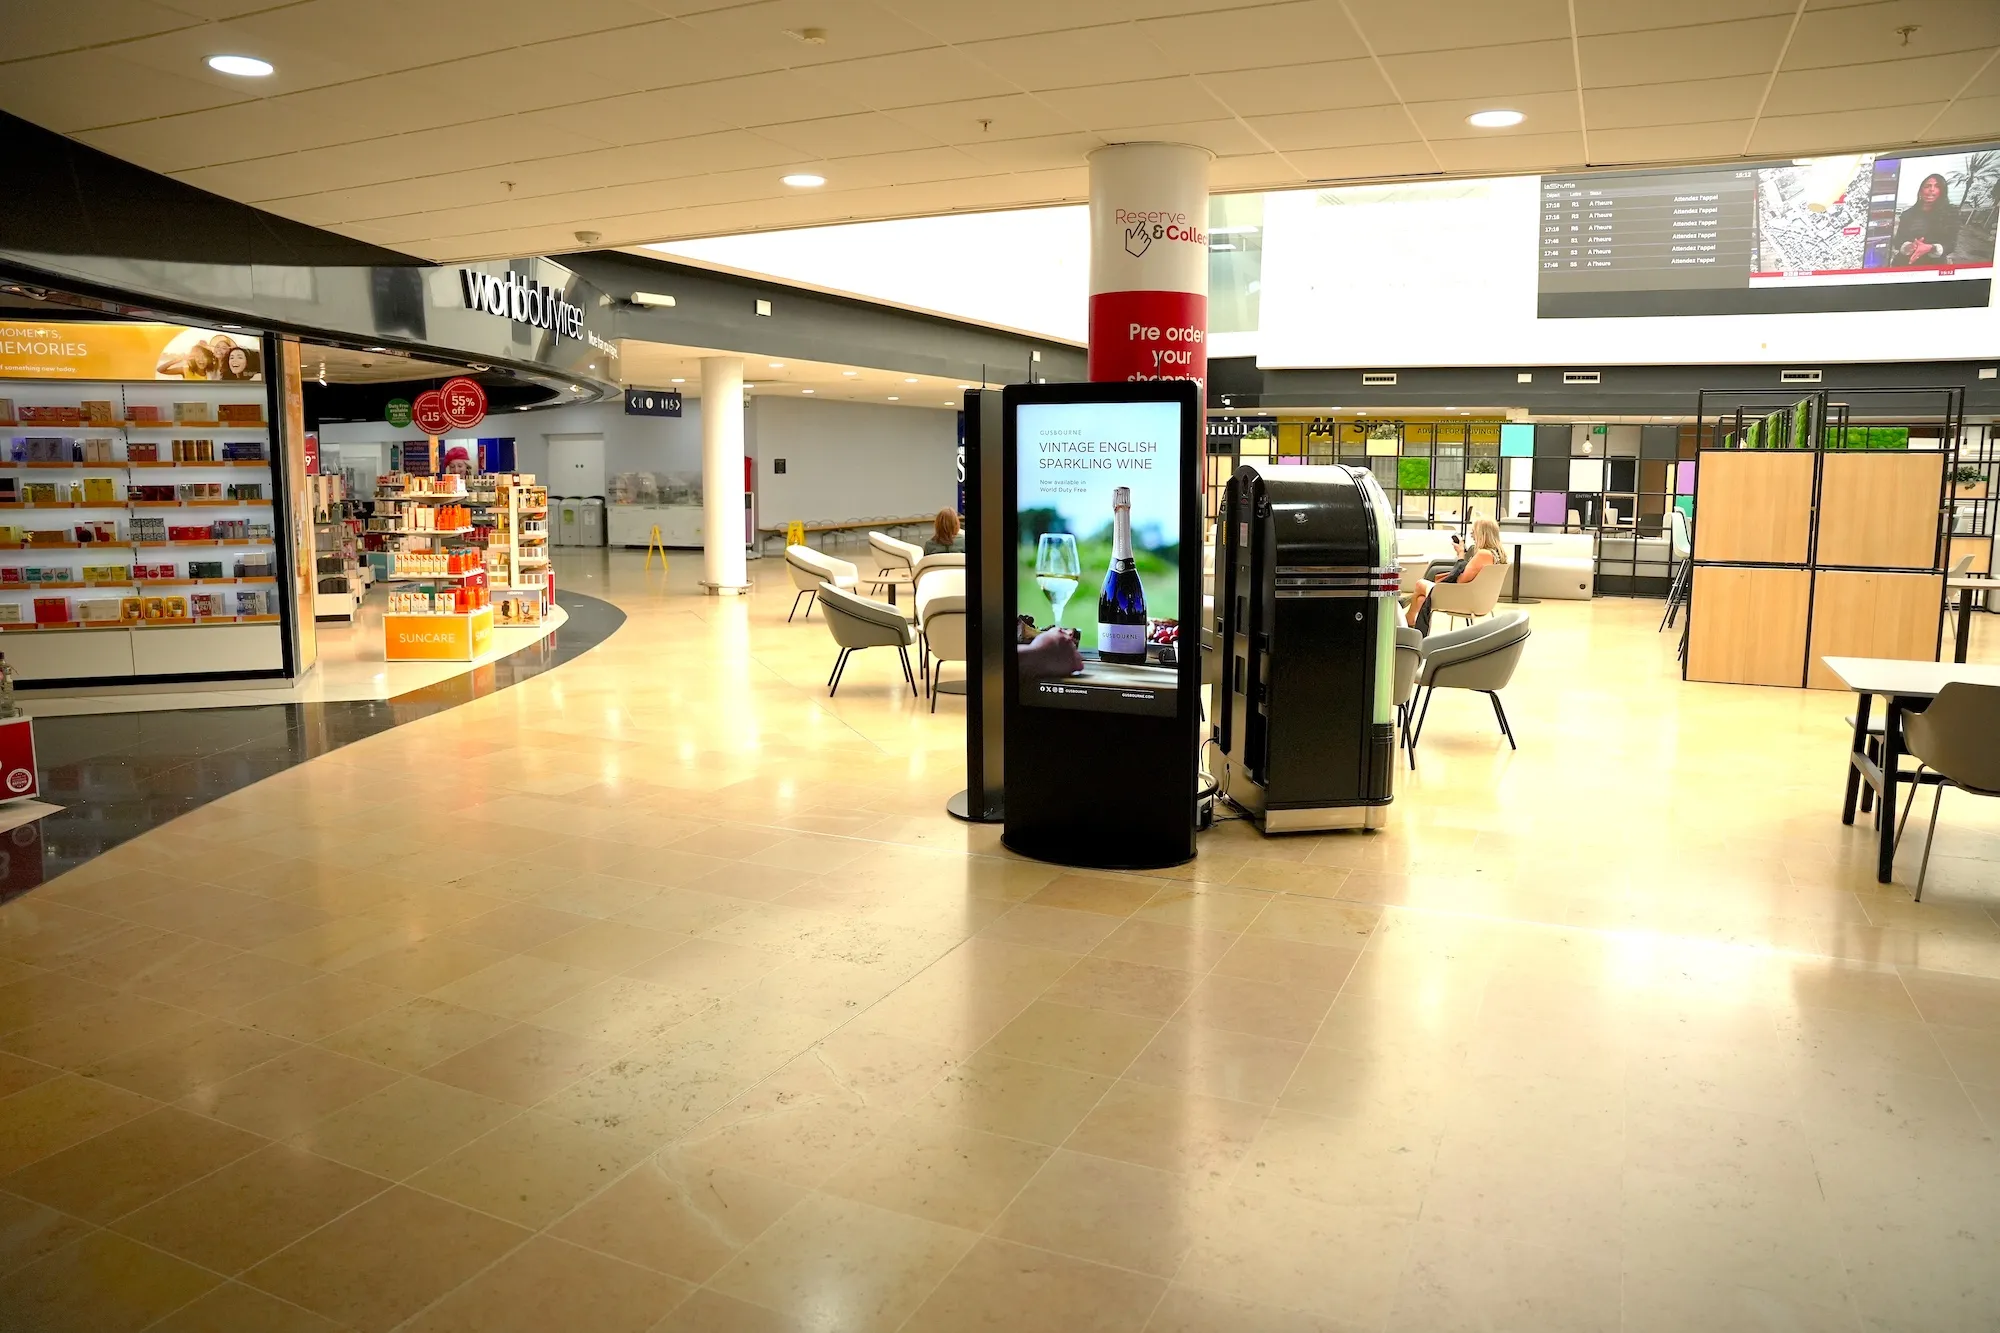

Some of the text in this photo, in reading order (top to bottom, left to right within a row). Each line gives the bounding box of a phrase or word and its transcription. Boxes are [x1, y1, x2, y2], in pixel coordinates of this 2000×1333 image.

[1115, 208, 1186, 225] Reserve
[1129, 323, 1204, 343] Pre order
[0, 341, 88, 357] EMORIES
[1152, 349, 1192, 367] your
[5, 365, 41, 373] something
[452, 396, 475, 406] 55%
[422, 412, 440, 422] £15
[1306, 417, 1335, 436] AA
[1039, 442, 1157, 453] VINTAGE ENGLISH
[1039, 458, 1152, 469] SPARKLING WINE
[399, 633, 456, 643] SUNCARE
